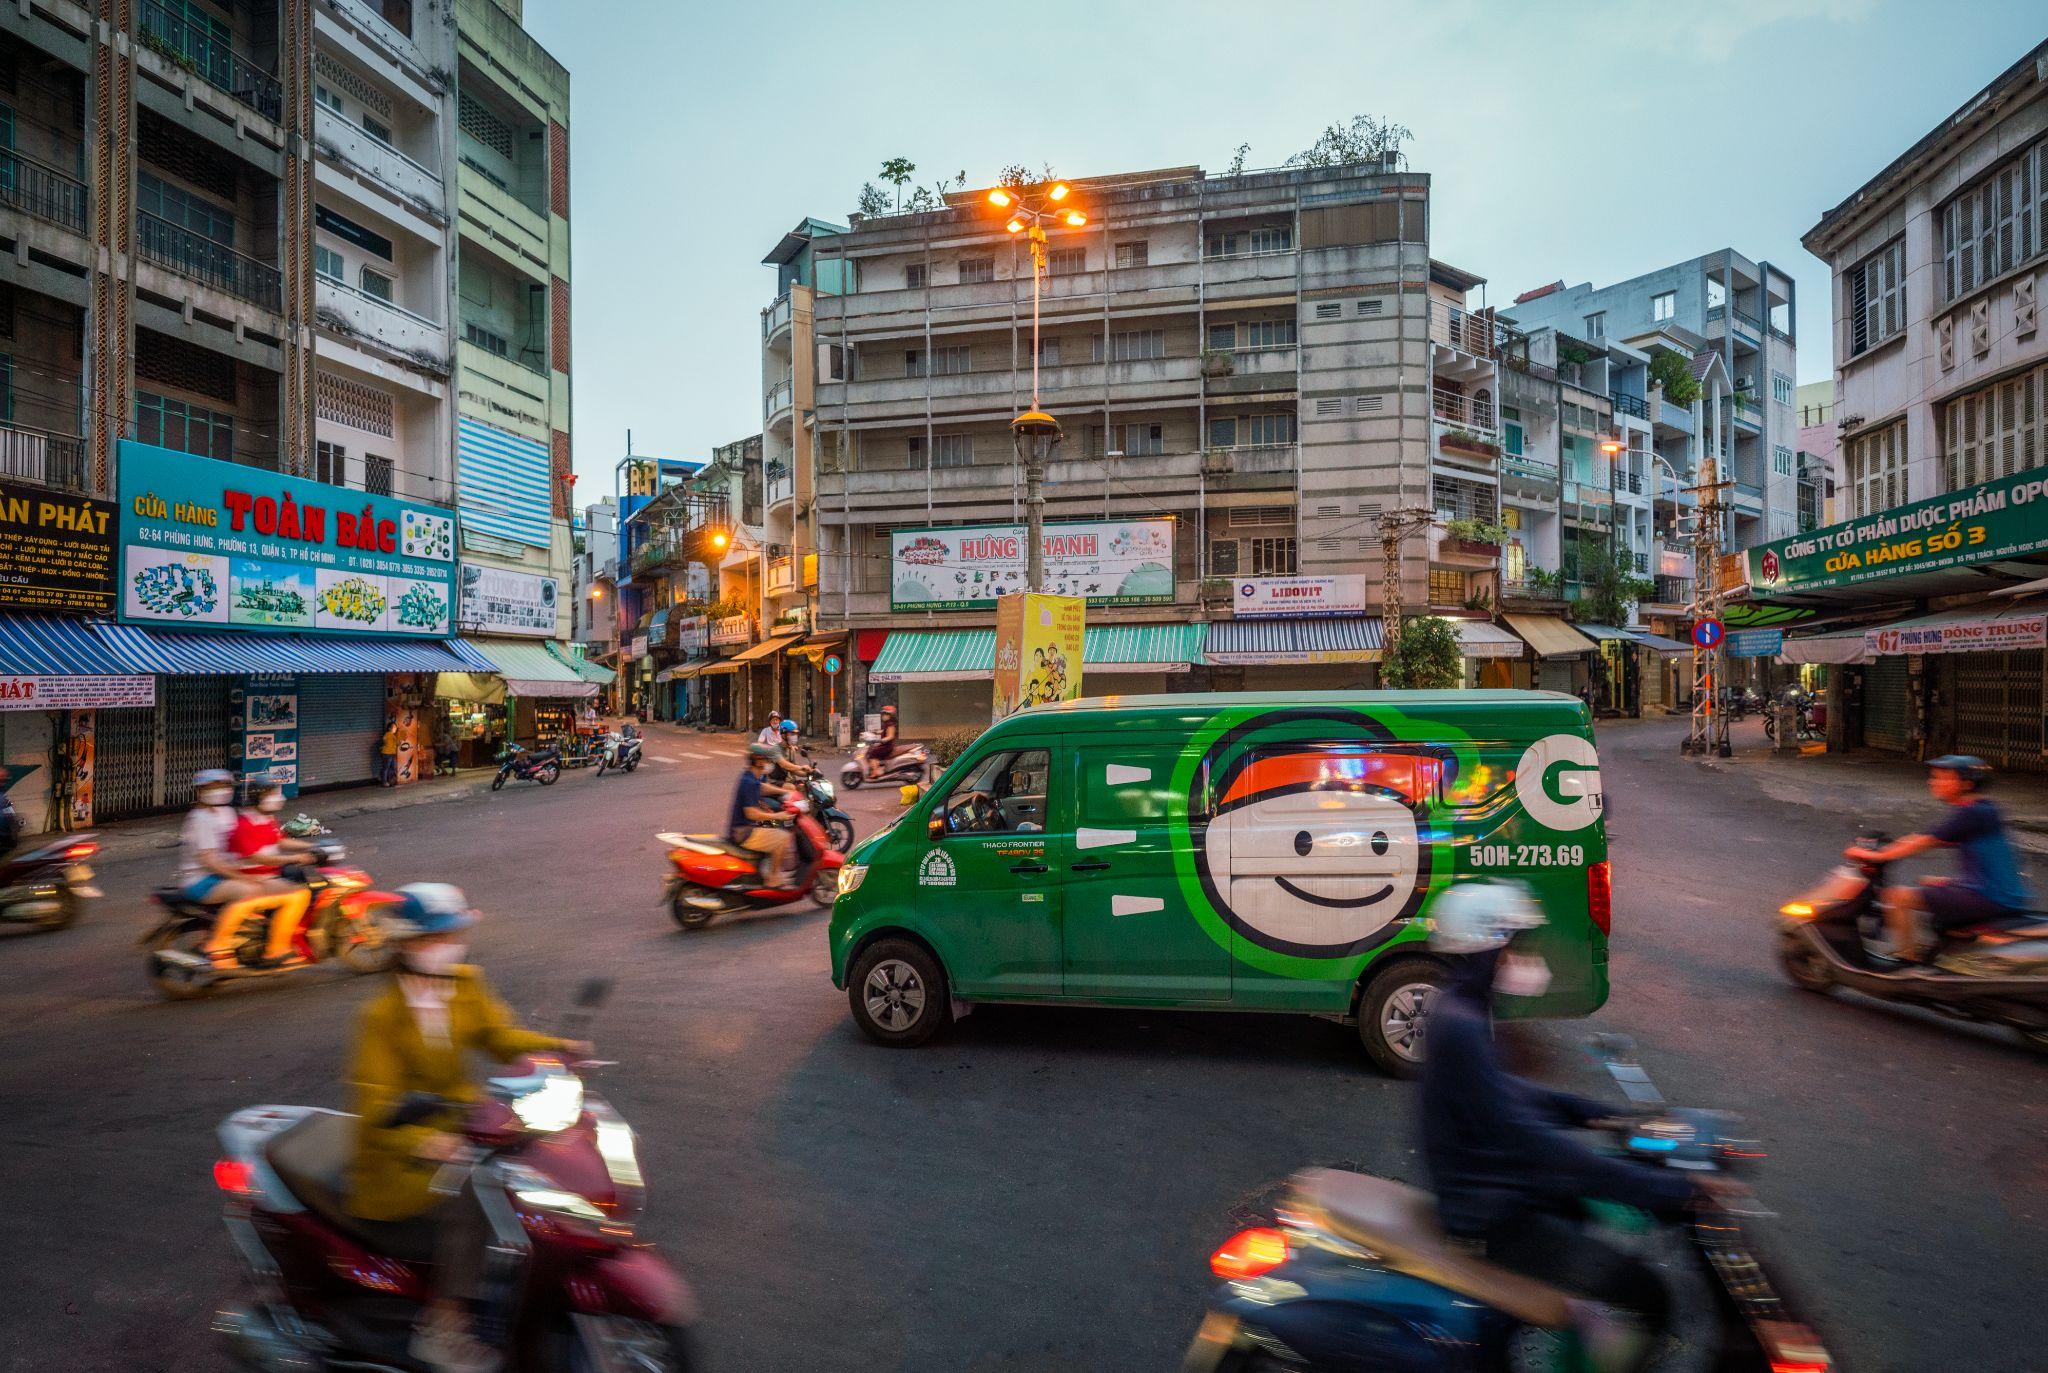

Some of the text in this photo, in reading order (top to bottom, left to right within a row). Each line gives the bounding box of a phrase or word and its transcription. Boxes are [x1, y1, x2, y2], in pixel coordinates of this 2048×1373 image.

[38, 501, 110, 535] PHÁT
[134, 490, 218, 528] CỬA HÀNG
[224, 488, 397, 554] TOÀN BẮC
[1784, 537, 1816, 561] CÔNG
[1817, 535, 1834, 555] TY
[1835, 523, 1855, 547] CỔ
[1857, 515, 1898, 544] PHẦN
[1899, 505, 1947, 535] DƯỢC
[1948, 486, 2007, 521] PHẨM
[139, 527, 162, 541] 62-64
[164, 529, 191, 546] PHÙNG
[960, 534, 1019, 562] HƯNG
[1825, 551, 1862, 574] CỬA
[1865, 541, 1922, 566] HÀNG
[1926, 521, 1963, 553] SỐ
[1967, 527, 1987, 546] 3
[41, 568, 57, 576] INOX
[1878, 631, 1900, 652] 67
[1900, 631, 1922, 645] PHÙNG
[1923, 629, 1942, 644] HƯNG
[1986, 622, 2043, 637] TRUNG
[1470, 844, 1584, 866] 50H-273.69
